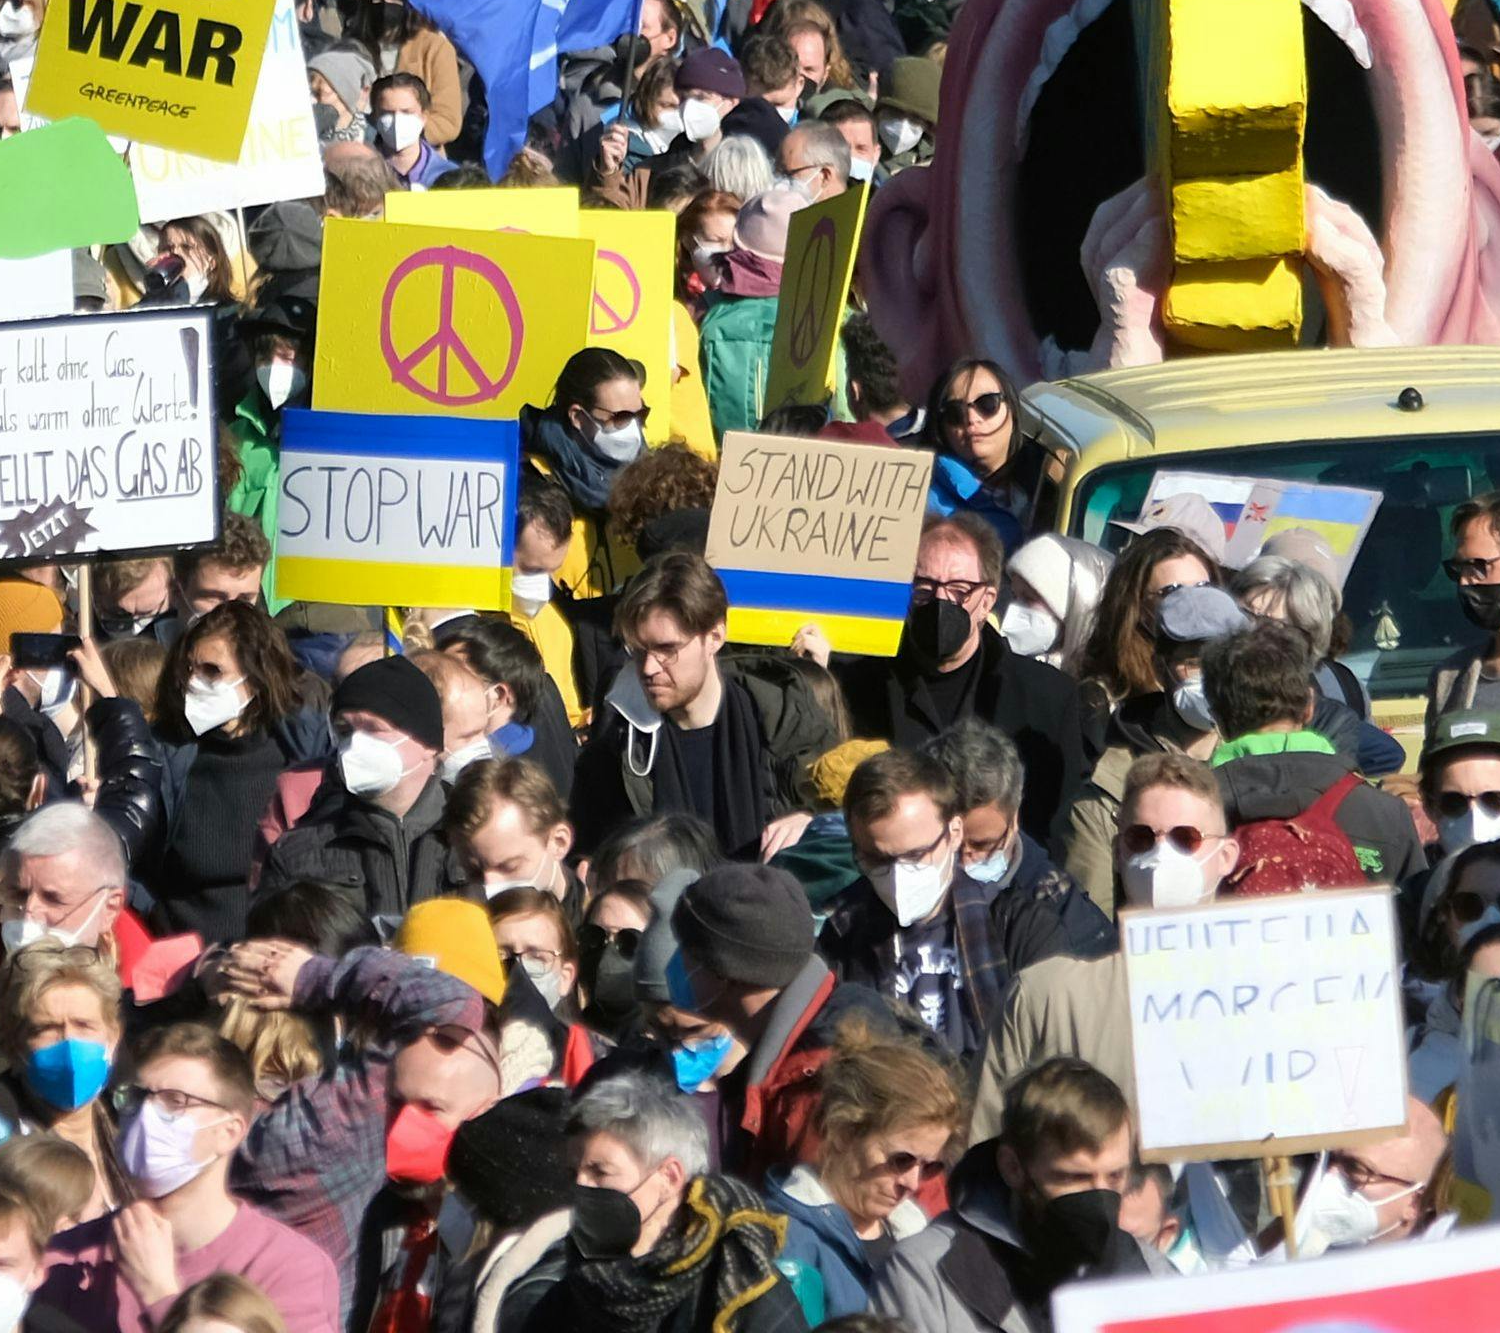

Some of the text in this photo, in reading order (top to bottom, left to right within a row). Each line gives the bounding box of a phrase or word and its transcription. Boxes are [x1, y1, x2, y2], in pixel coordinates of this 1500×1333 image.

[79, 82, 197, 120] GREENPEACE
[16, 335, 50, 383] kalt
[57, 334, 89, 381] ohne
[28, 407, 69, 431] warm
[82, 380, 120, 429] ohne
[66, 444, 109, 502] DAS
[115, 430, 168, 498] GAS
[174, 436, 203, 494] AB
[724, 447, 930, 513] STAND WITH
[19, 510, 74, 557] JETZT
[280, 466, 502, 549] STOP WAR
[729, 504, 900, 562] UKRAINE
